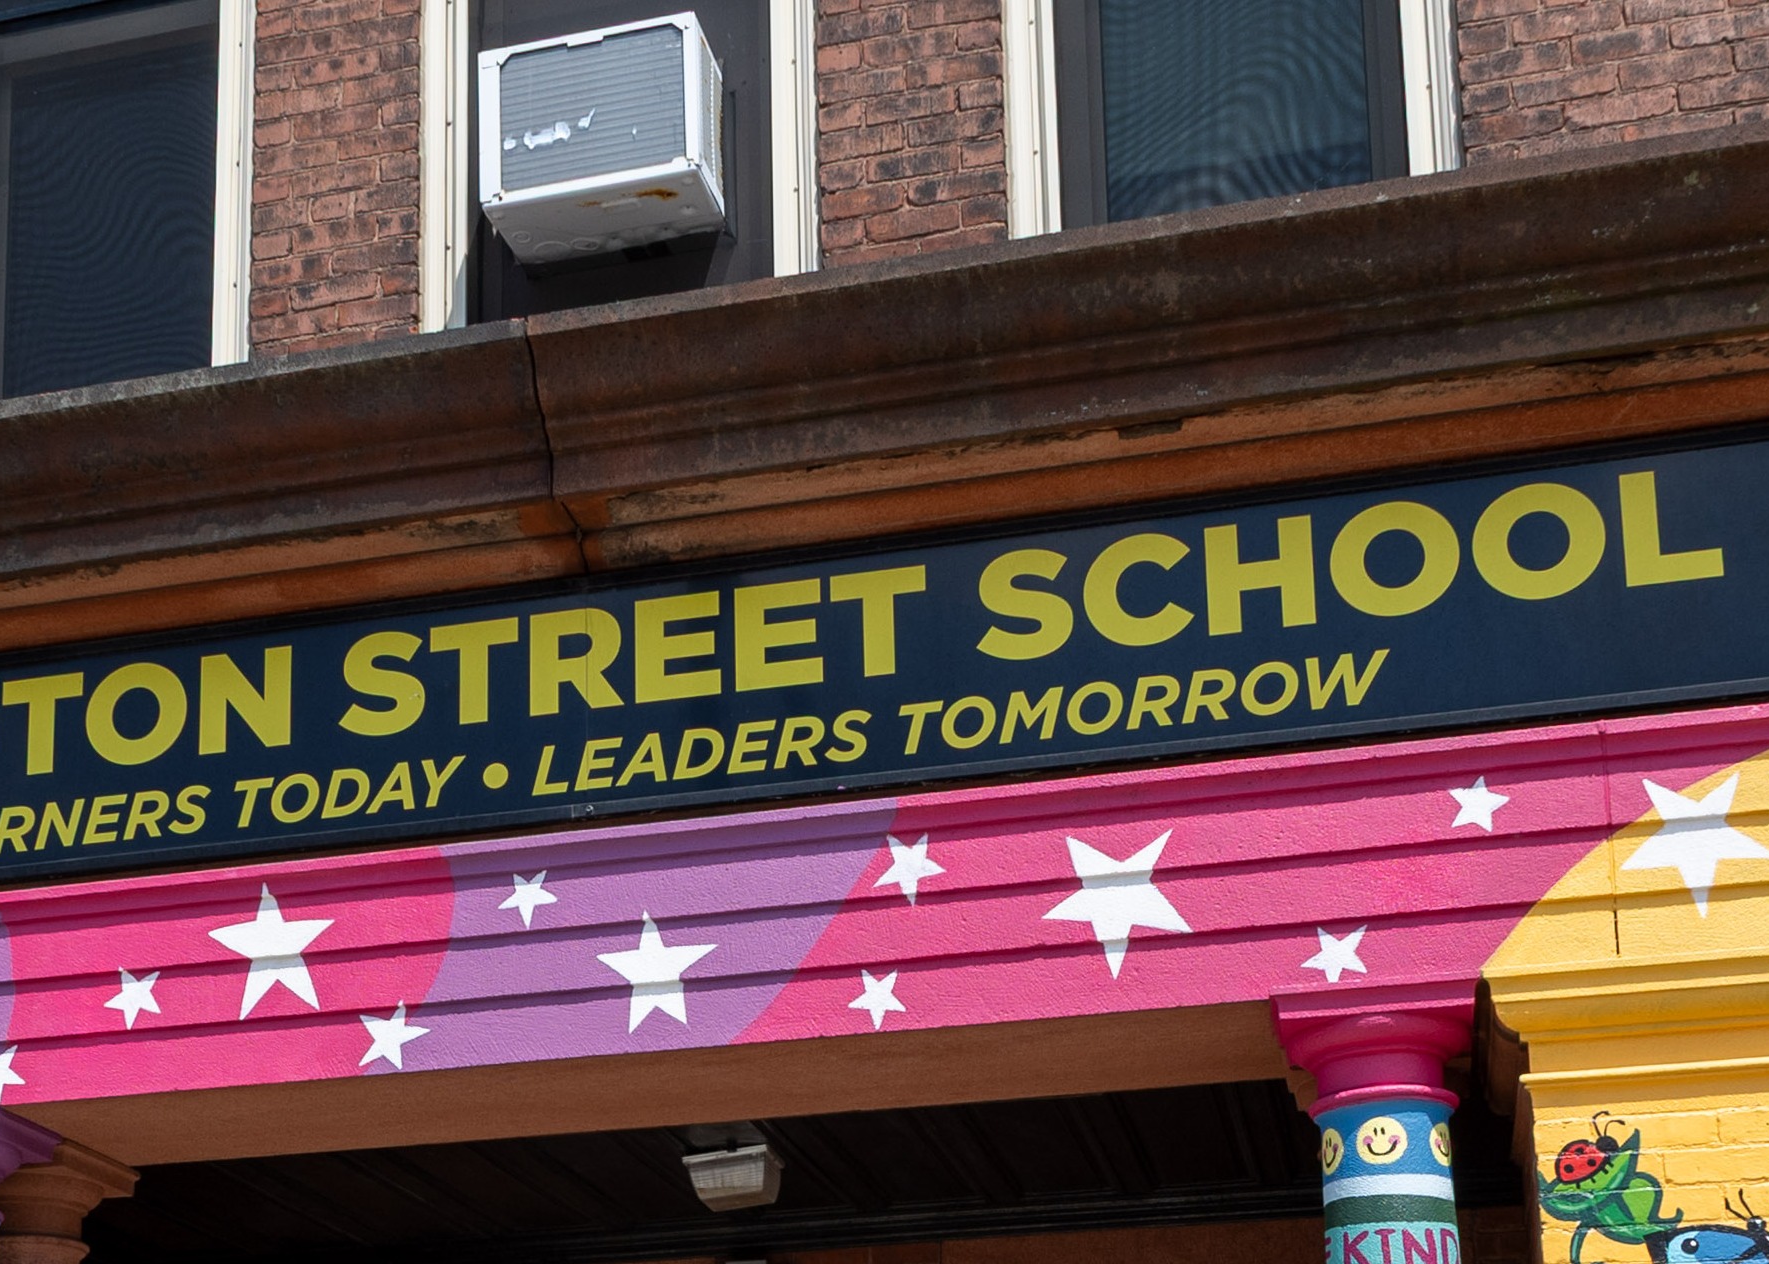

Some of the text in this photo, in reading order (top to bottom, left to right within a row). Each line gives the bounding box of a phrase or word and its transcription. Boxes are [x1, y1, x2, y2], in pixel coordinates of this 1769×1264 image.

[340, 565, 927, 738] STREET
[977, 471, 1727, 662] SCHOOL
[234, 755, 466, 829] TODAY
[531, 709, 873, 798] LEADERS
[900, 648, 1390, 756] TOMORROW
